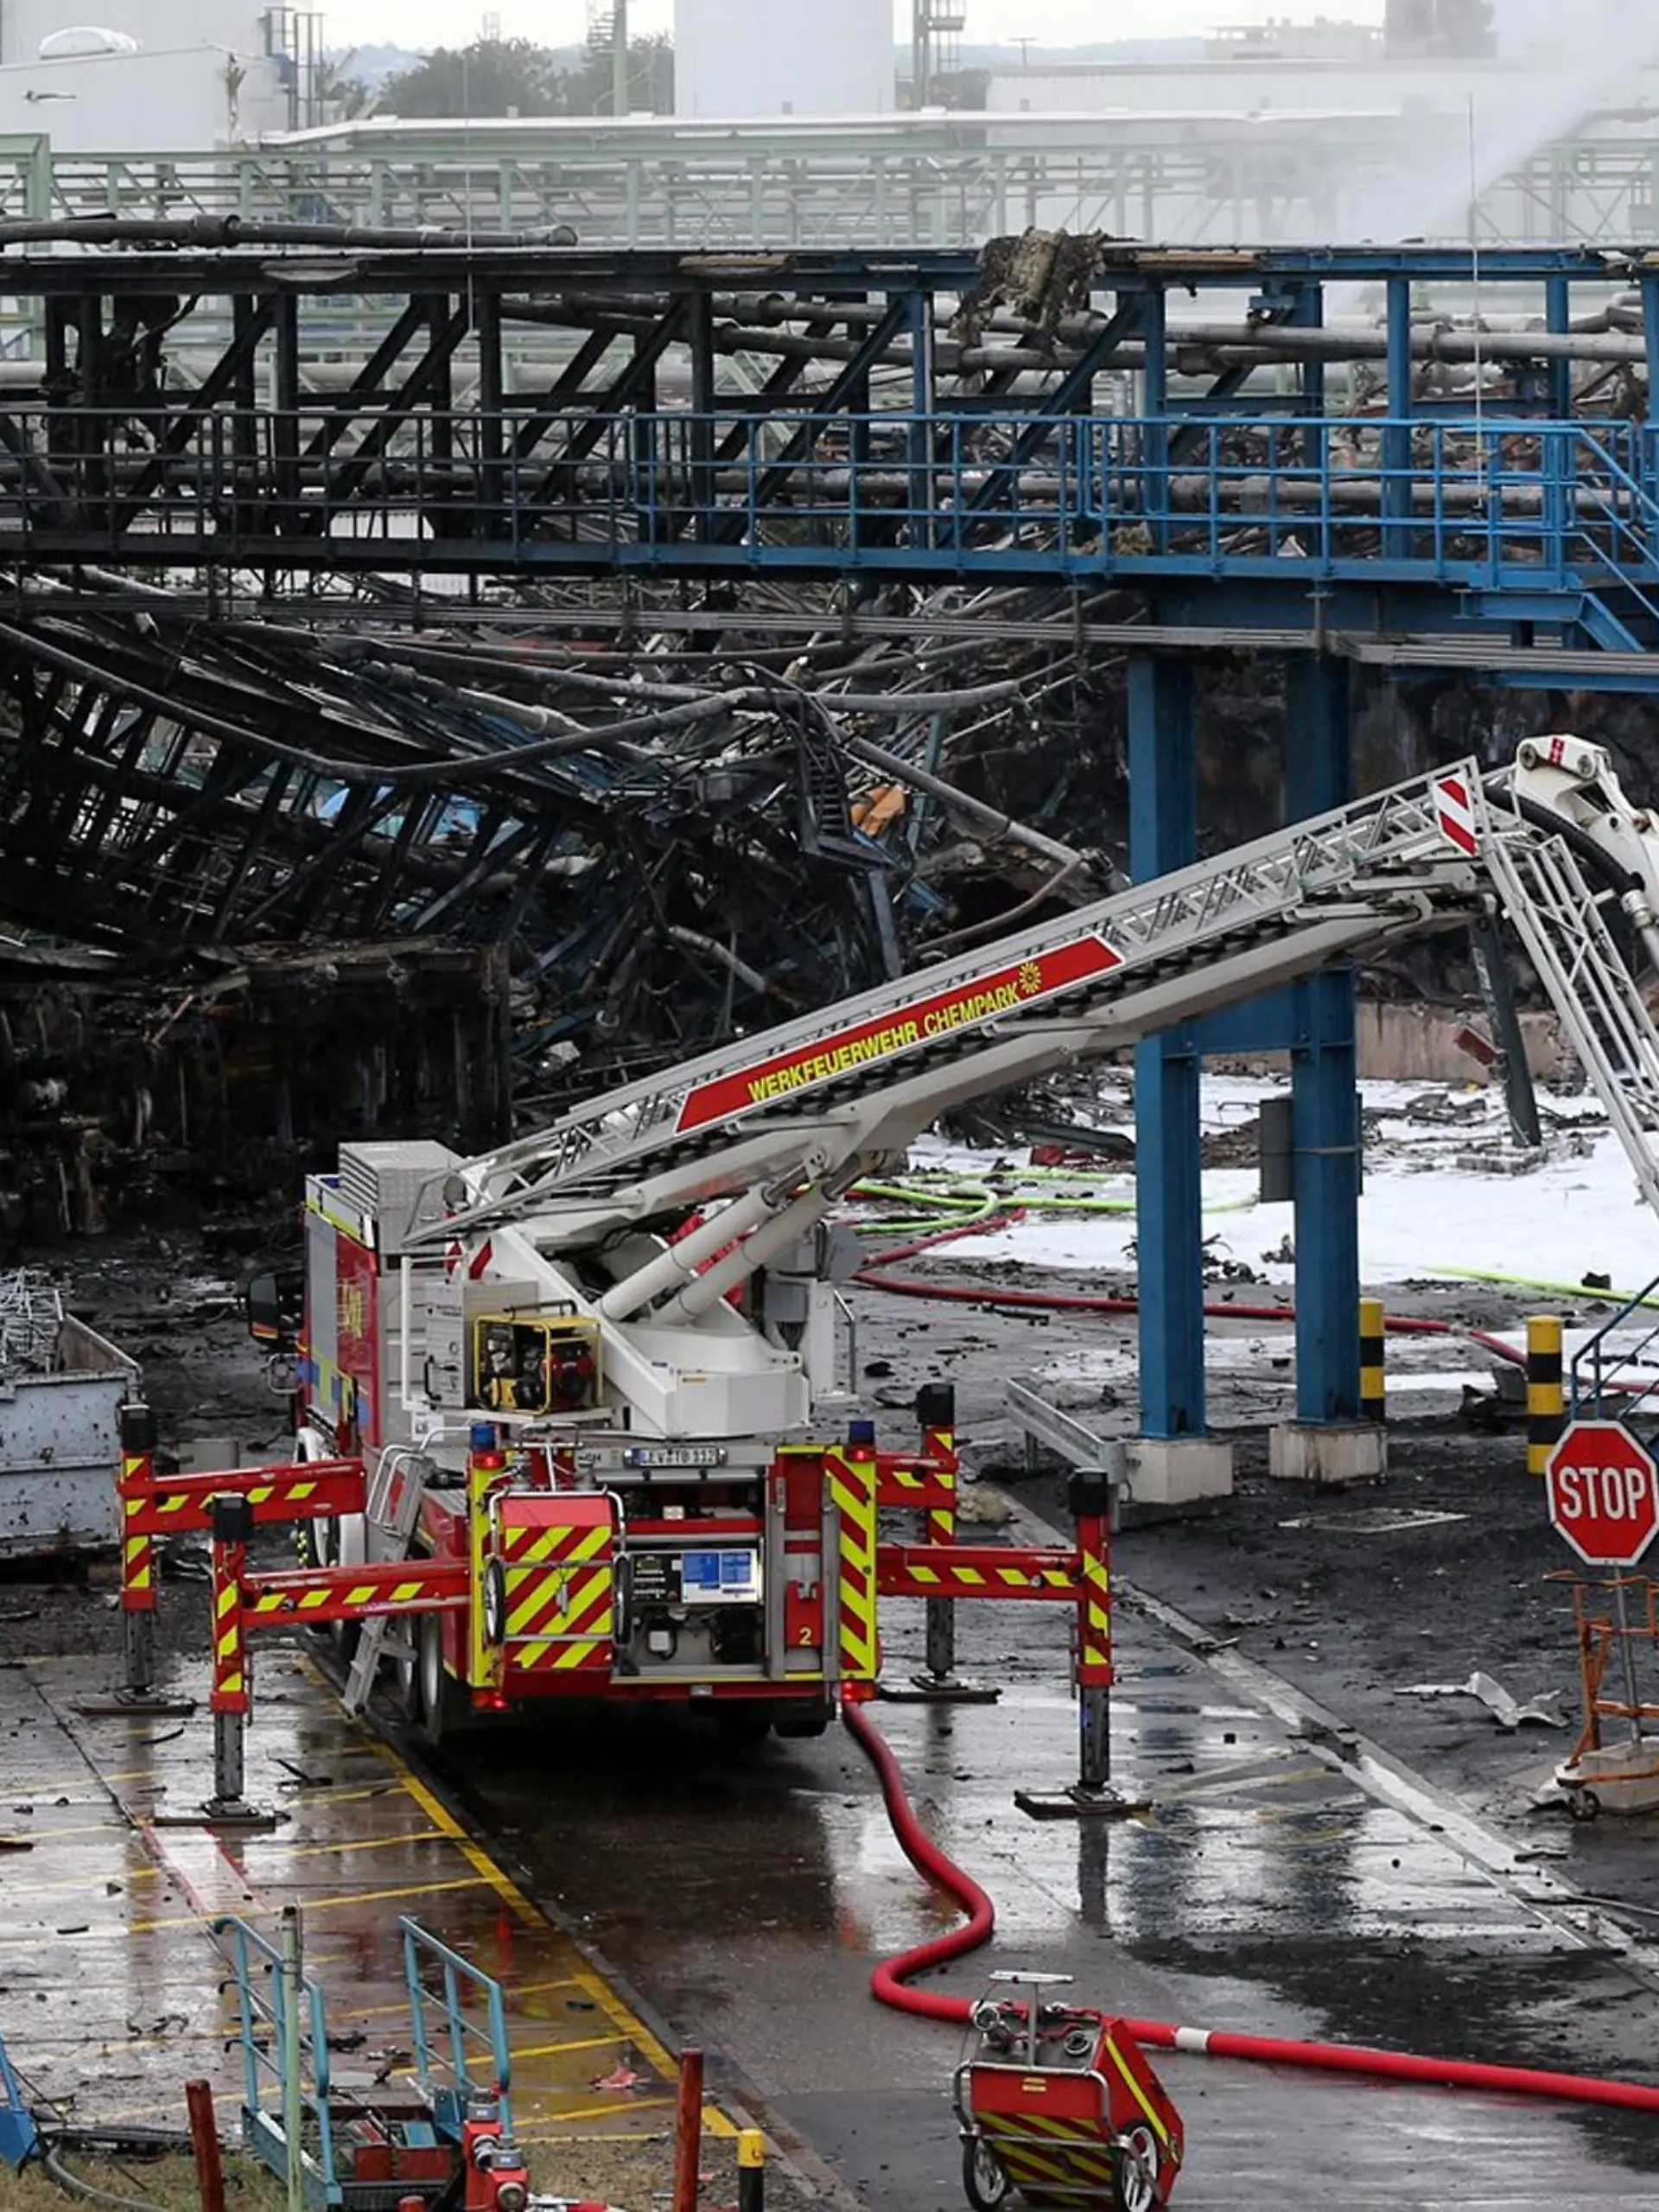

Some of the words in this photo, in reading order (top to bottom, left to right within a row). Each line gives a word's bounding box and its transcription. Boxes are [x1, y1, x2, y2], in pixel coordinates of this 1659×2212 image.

[747, 1020, 918, 1103] WERKFEUERWEHR
[923, 980, 1020, 1035] CHEMPARK
[1558, 1465, 1647, 1521] STOP
[799, 1626, 812, 1646] 2
